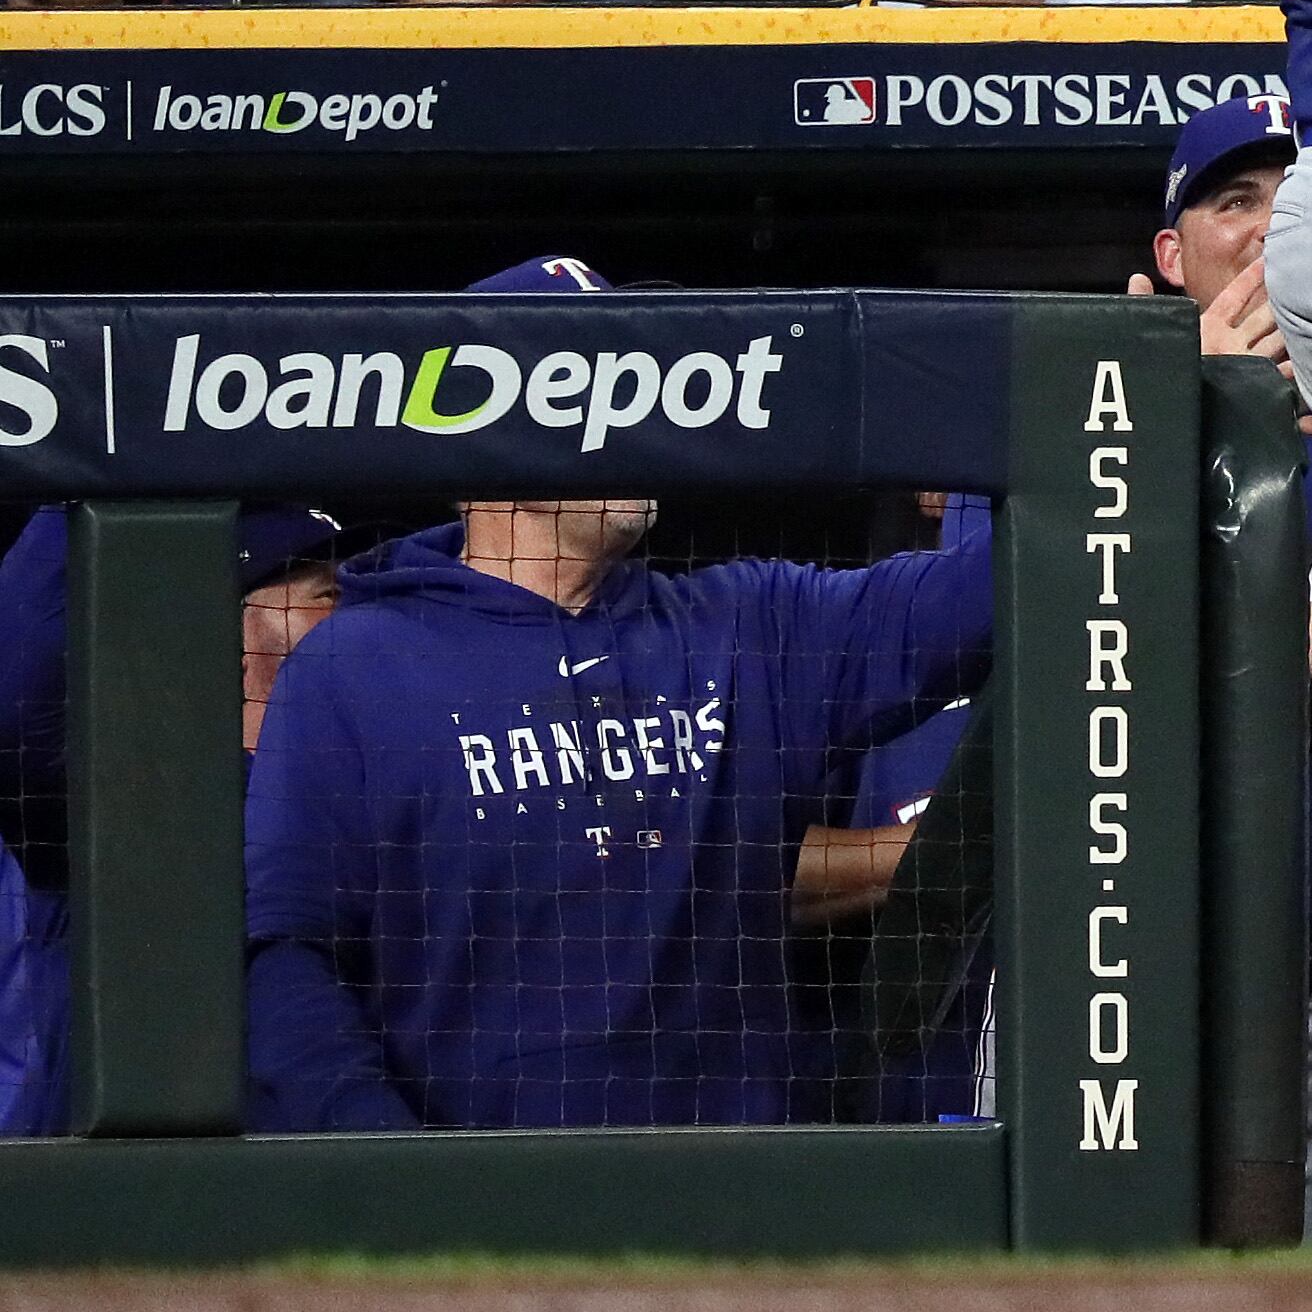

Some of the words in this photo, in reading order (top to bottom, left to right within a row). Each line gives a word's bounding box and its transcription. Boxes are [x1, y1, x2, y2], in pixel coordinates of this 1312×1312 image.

[153, 84, 438, 142] loanDepot
[1247, 94, 1292, 135] T
[541, 257, 601, 291] T
[163, 333, 783, 453] loanDepot
[457, 696, 726, 797] RANGERS
[585, 825, 612, 857] T
